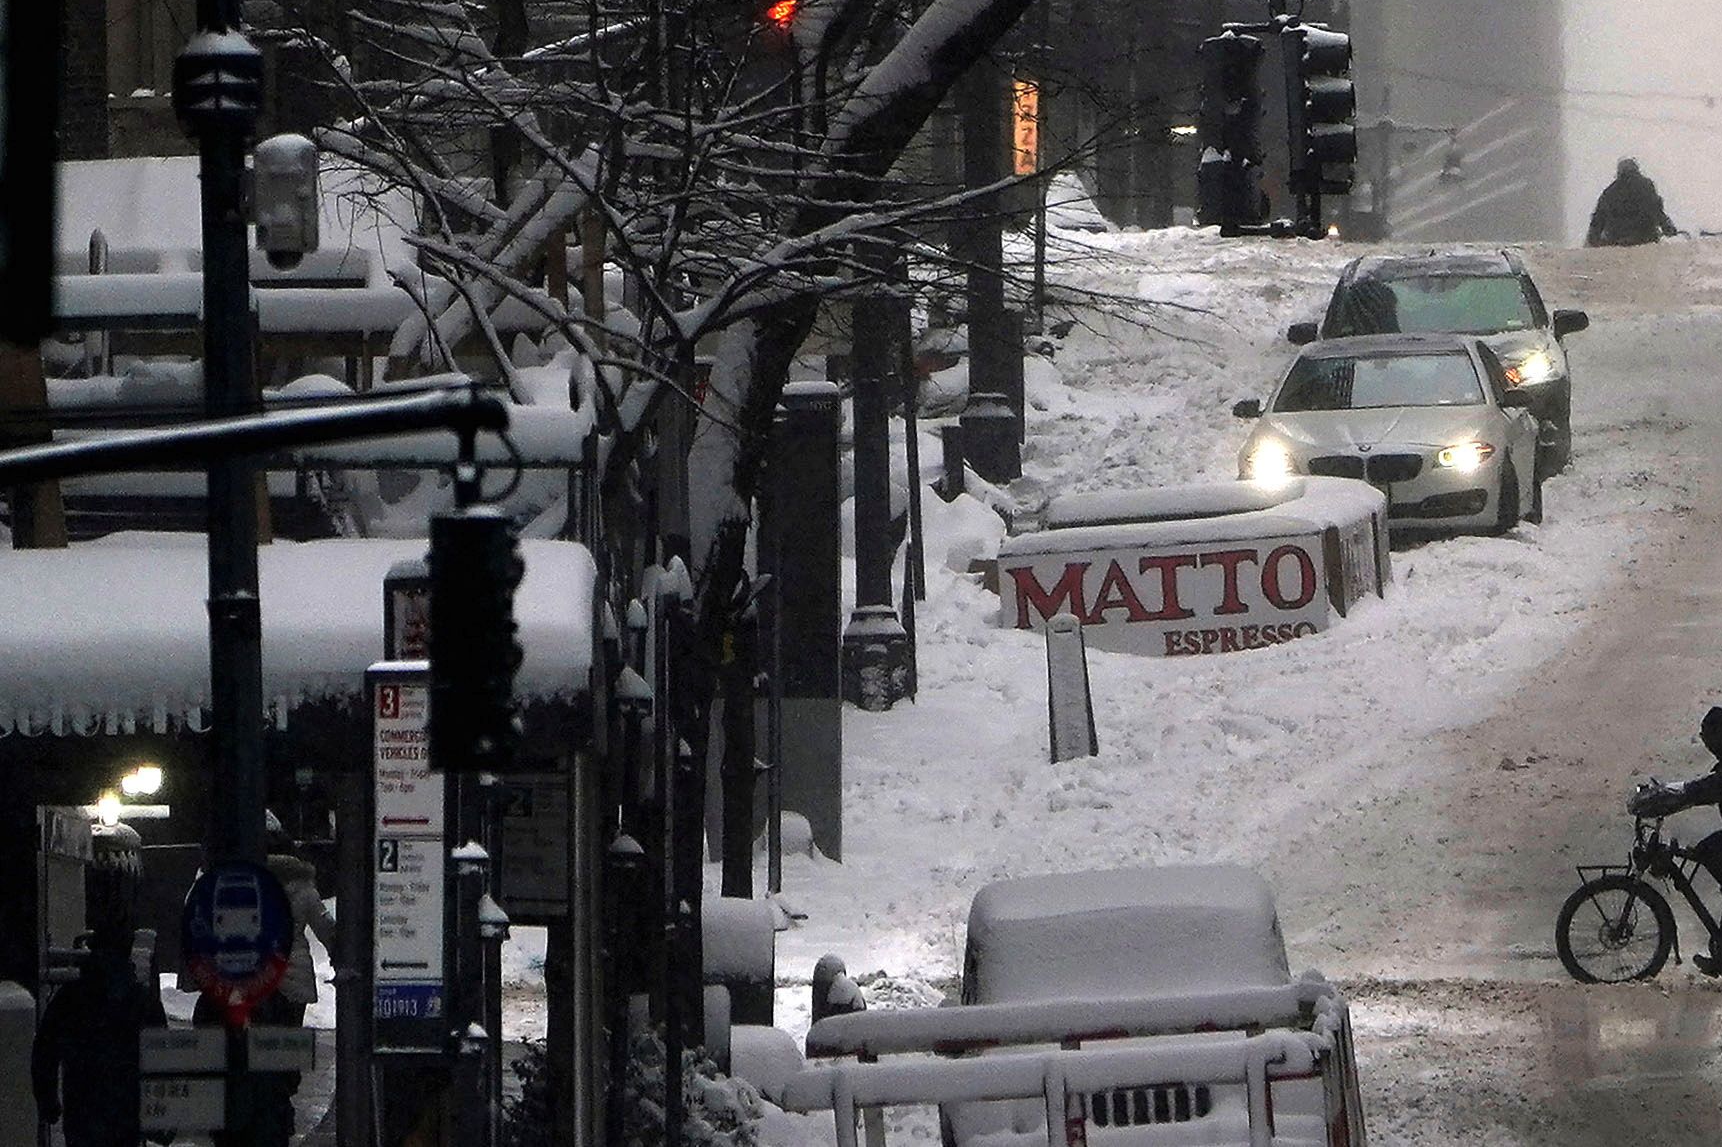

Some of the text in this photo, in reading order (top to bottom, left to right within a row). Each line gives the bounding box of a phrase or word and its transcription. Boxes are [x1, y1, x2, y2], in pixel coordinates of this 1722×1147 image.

[1005, 544, 1317, 629] MATTO
[1163, 621, 1318, 657] ESPRESSO
[382, 687, 394, 715] 3
[382, 840, 393, 869] 2
